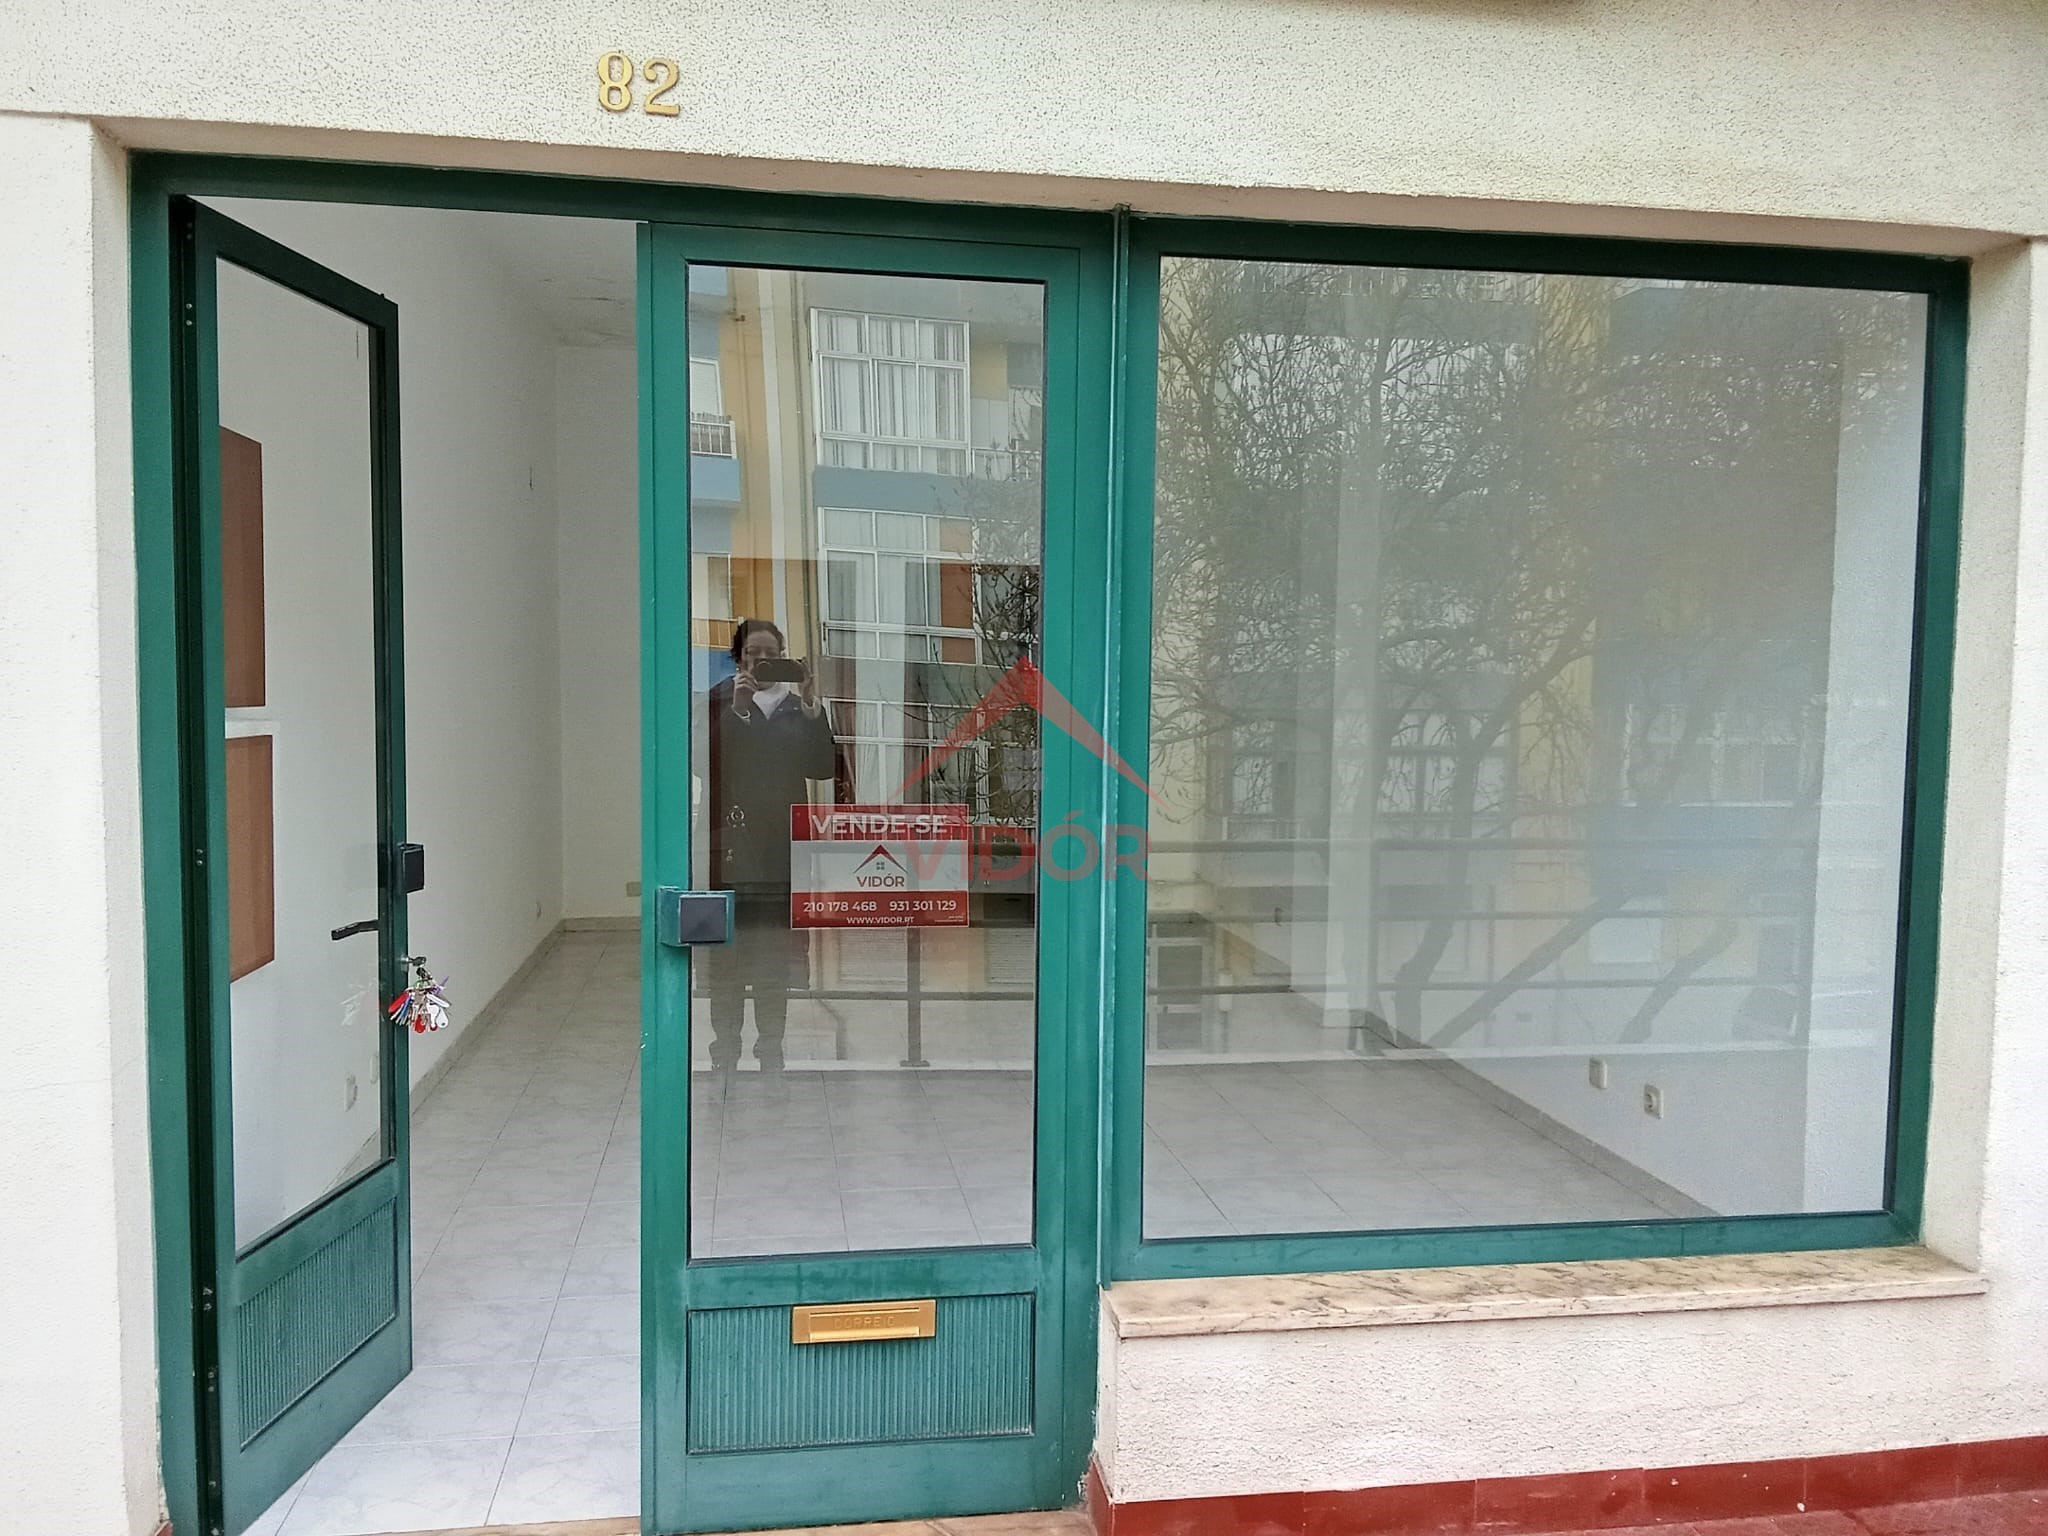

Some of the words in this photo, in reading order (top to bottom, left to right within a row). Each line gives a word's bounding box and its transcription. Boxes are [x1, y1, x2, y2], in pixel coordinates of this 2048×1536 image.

[597, 51, 681, 116] 82
[811, 814, 948, 834] VENDE-SE
[856, 873, 905, 888] VIDÓR
[803, 901, 825, 913] 210
[827, 901, 849, 912] 178
[852, 900, 878, 911] 468
[889, 900, 910, 911] 931
[912, 900, 933, 911] 301
[936, 899, 957, 911] 129
[846, 915, 914, 925] WWW.VIDOR.PT
